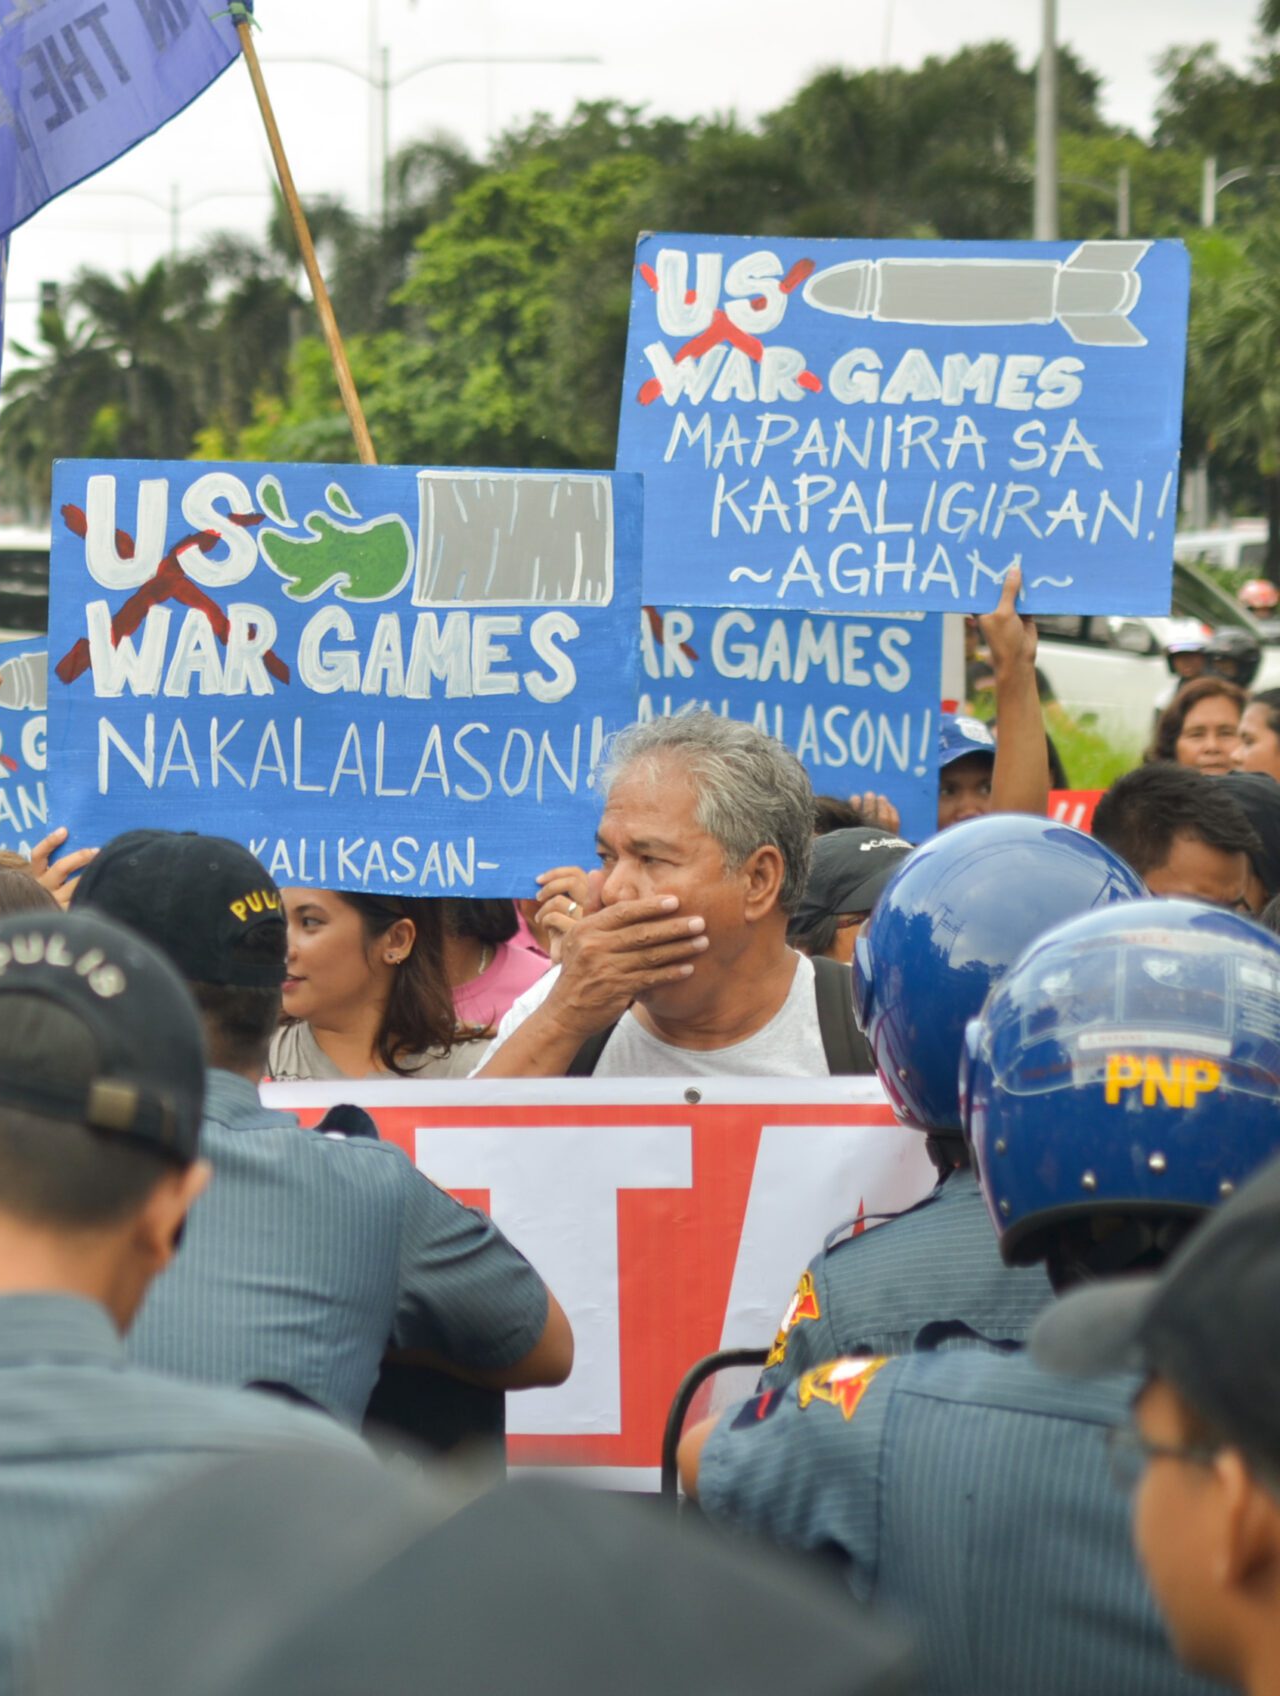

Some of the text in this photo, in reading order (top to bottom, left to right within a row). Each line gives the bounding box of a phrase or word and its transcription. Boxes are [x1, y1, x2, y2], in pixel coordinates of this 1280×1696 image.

[655, 249, 788, 337] US
[643, 341, 1084, 411] WAR GAMES
[664, 412, 1103, 478] MAPANIRA SA
[85, 472, 258, 590] US
[711, 471, 1173, 544] KAPALIGIRAN!
[86, 600, 580, 703] WAR GAMES
[640, 610, 911, 693] AR GAMES
[97, 713, 603, 803] NAKALALASON!
[1104, 1054, 1221, 1108] PNP
